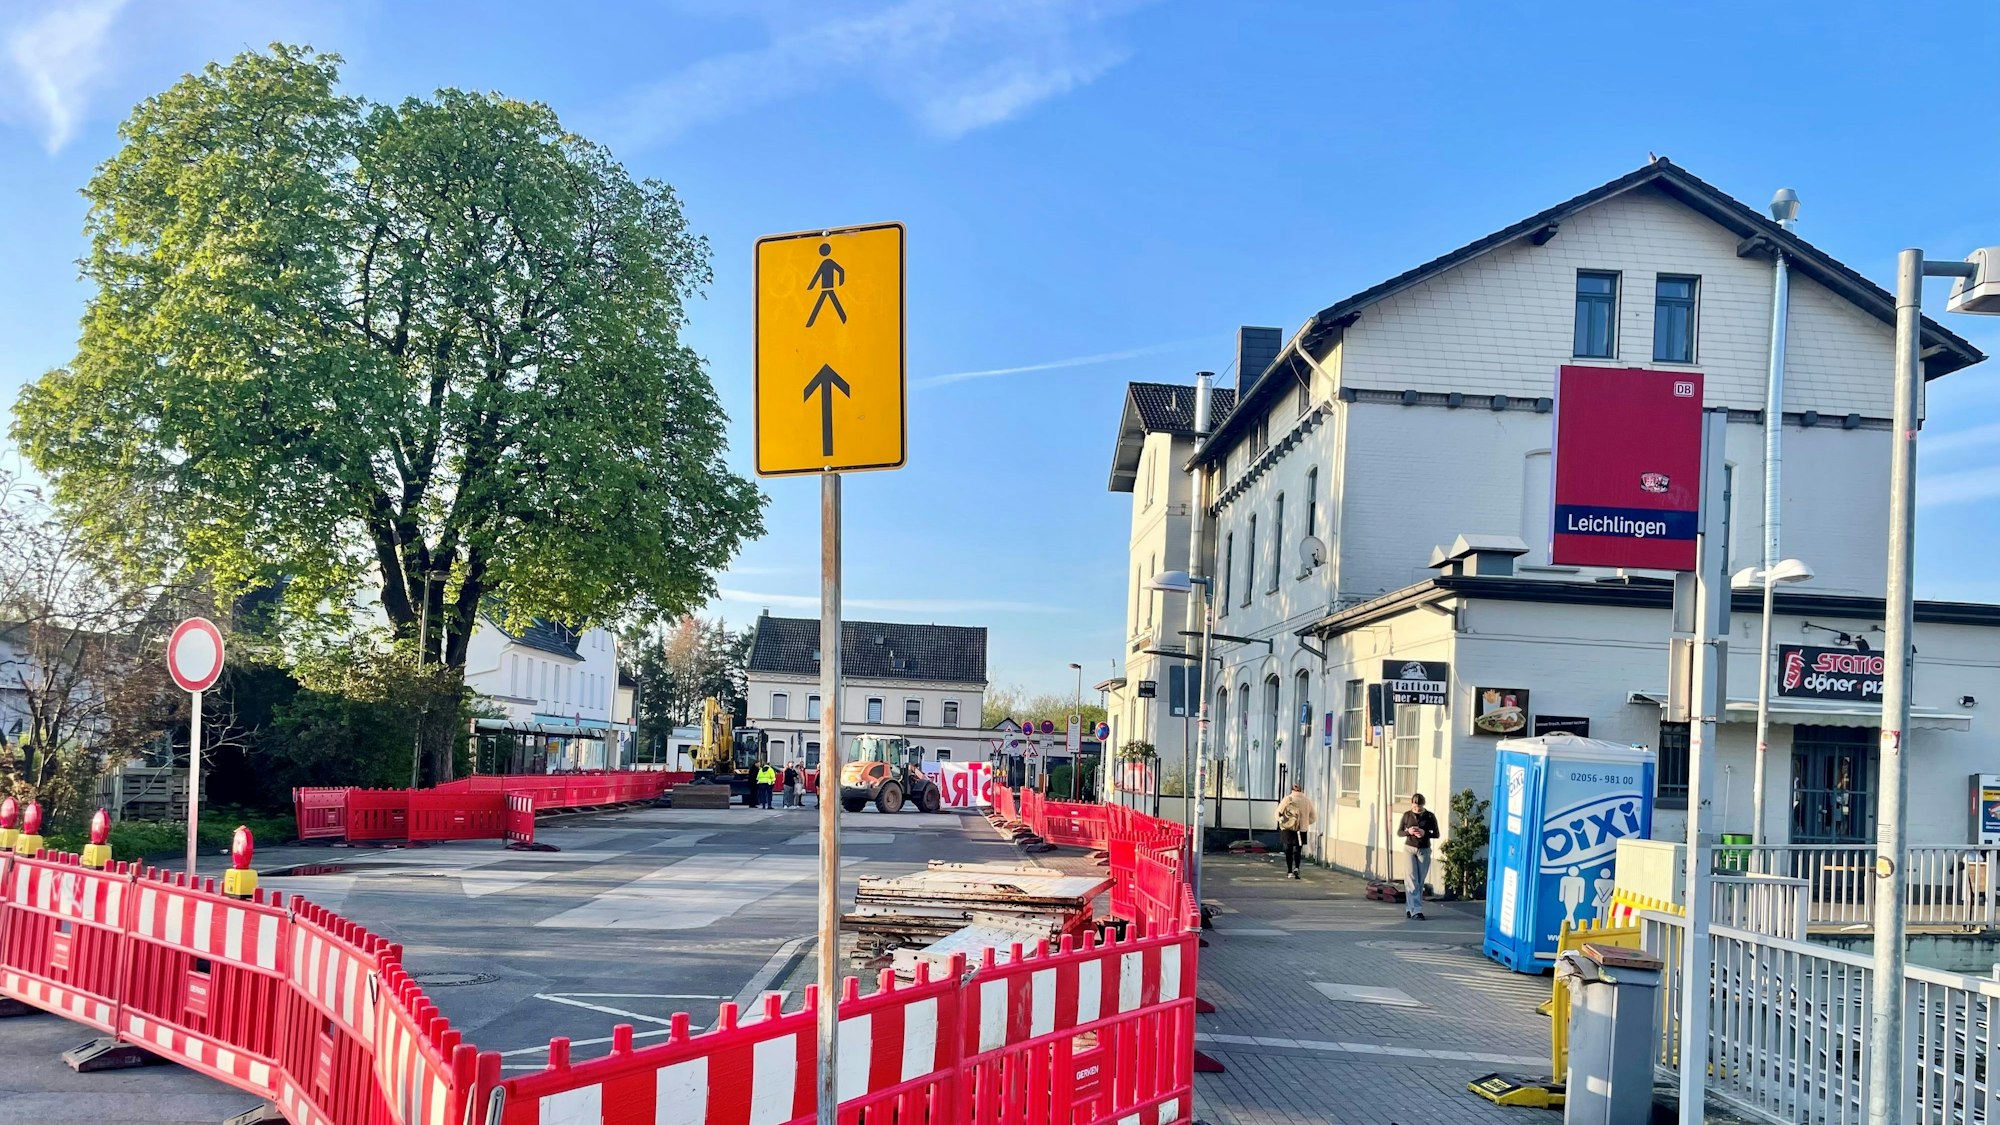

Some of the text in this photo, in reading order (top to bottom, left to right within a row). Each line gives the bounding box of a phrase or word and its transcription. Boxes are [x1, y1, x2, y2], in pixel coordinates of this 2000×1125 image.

[1677, 384, 1691, 394] DB
[1568, 513, 1666, 538] Leichlingen
[1811, 653, 1884, 675] STATIO
[1394, 681, 1440, 692] tation
[1862, 680, 1884, 696] piz
[1393, 692, 1411, 703] ner
[1419, 694, 1444, 704] Pizza
[1570, 772, 1597, 783] 02056
[1604, 774, 1620, 784] 981
[1622, 776, 1634, 785] 00
[1076, 1065, 1099, 1080] GERKEN
